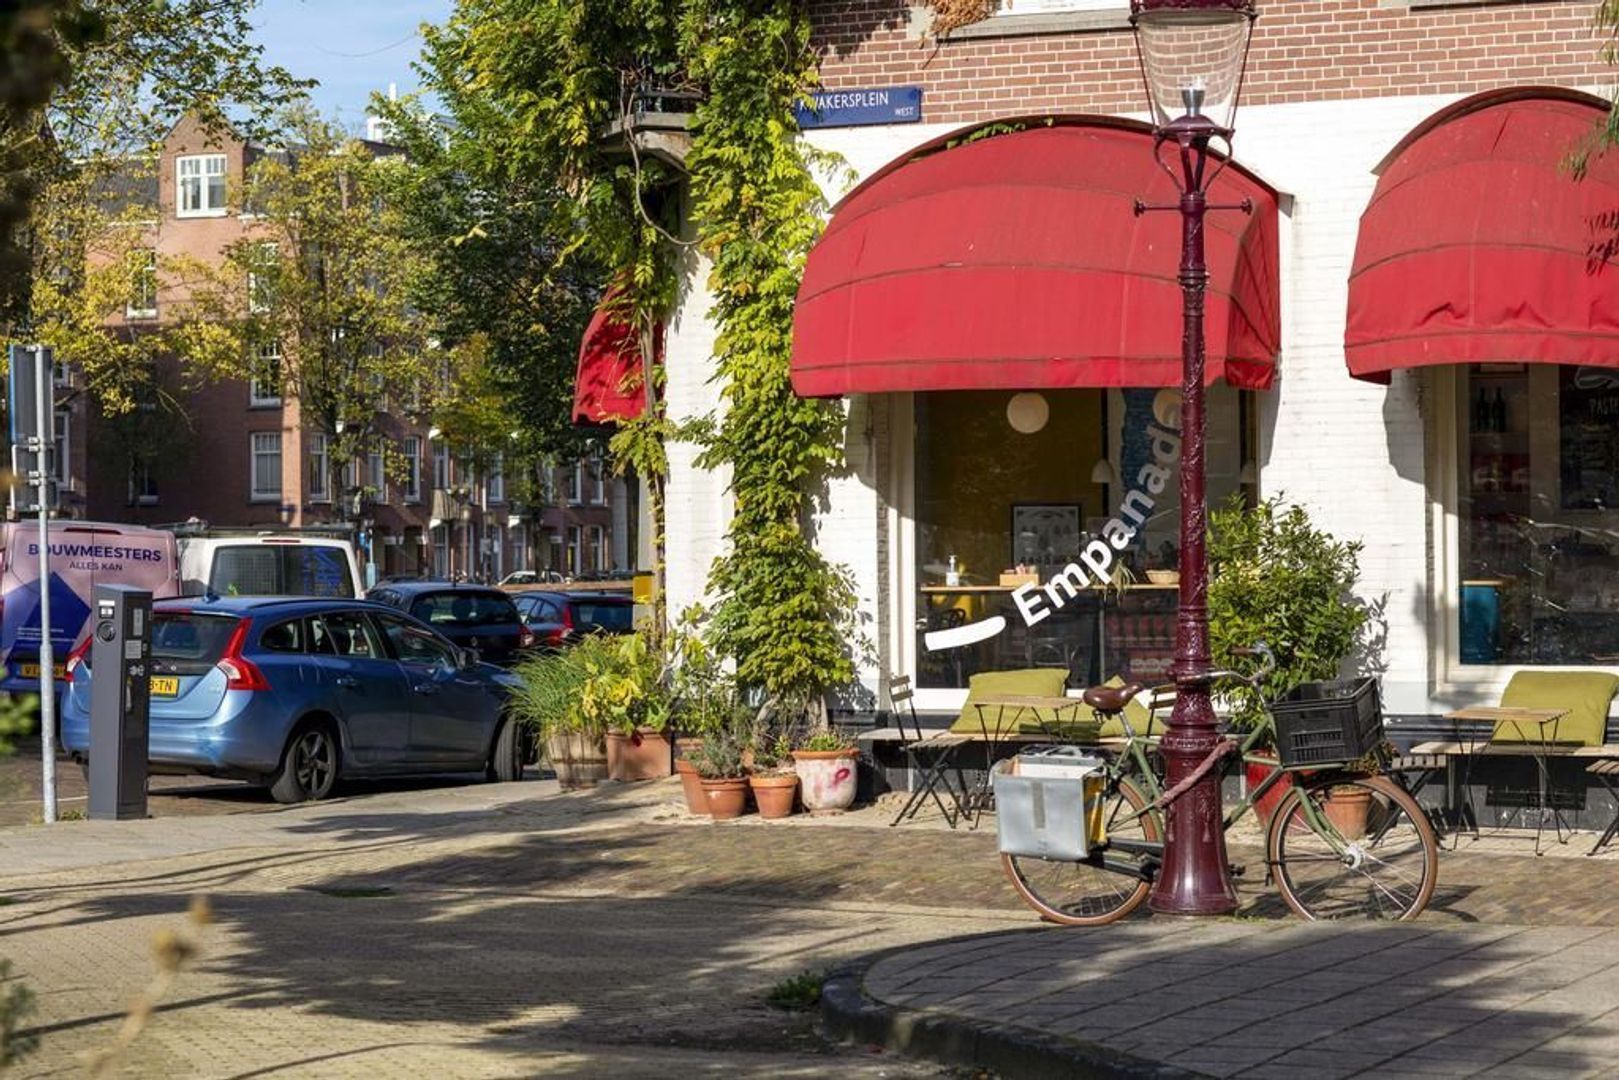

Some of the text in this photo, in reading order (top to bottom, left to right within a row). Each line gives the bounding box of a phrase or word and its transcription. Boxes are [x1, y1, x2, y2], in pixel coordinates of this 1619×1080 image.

[894, 106, 915, 116] WEST
[69, 561, 123, 571] ALLES KAN
